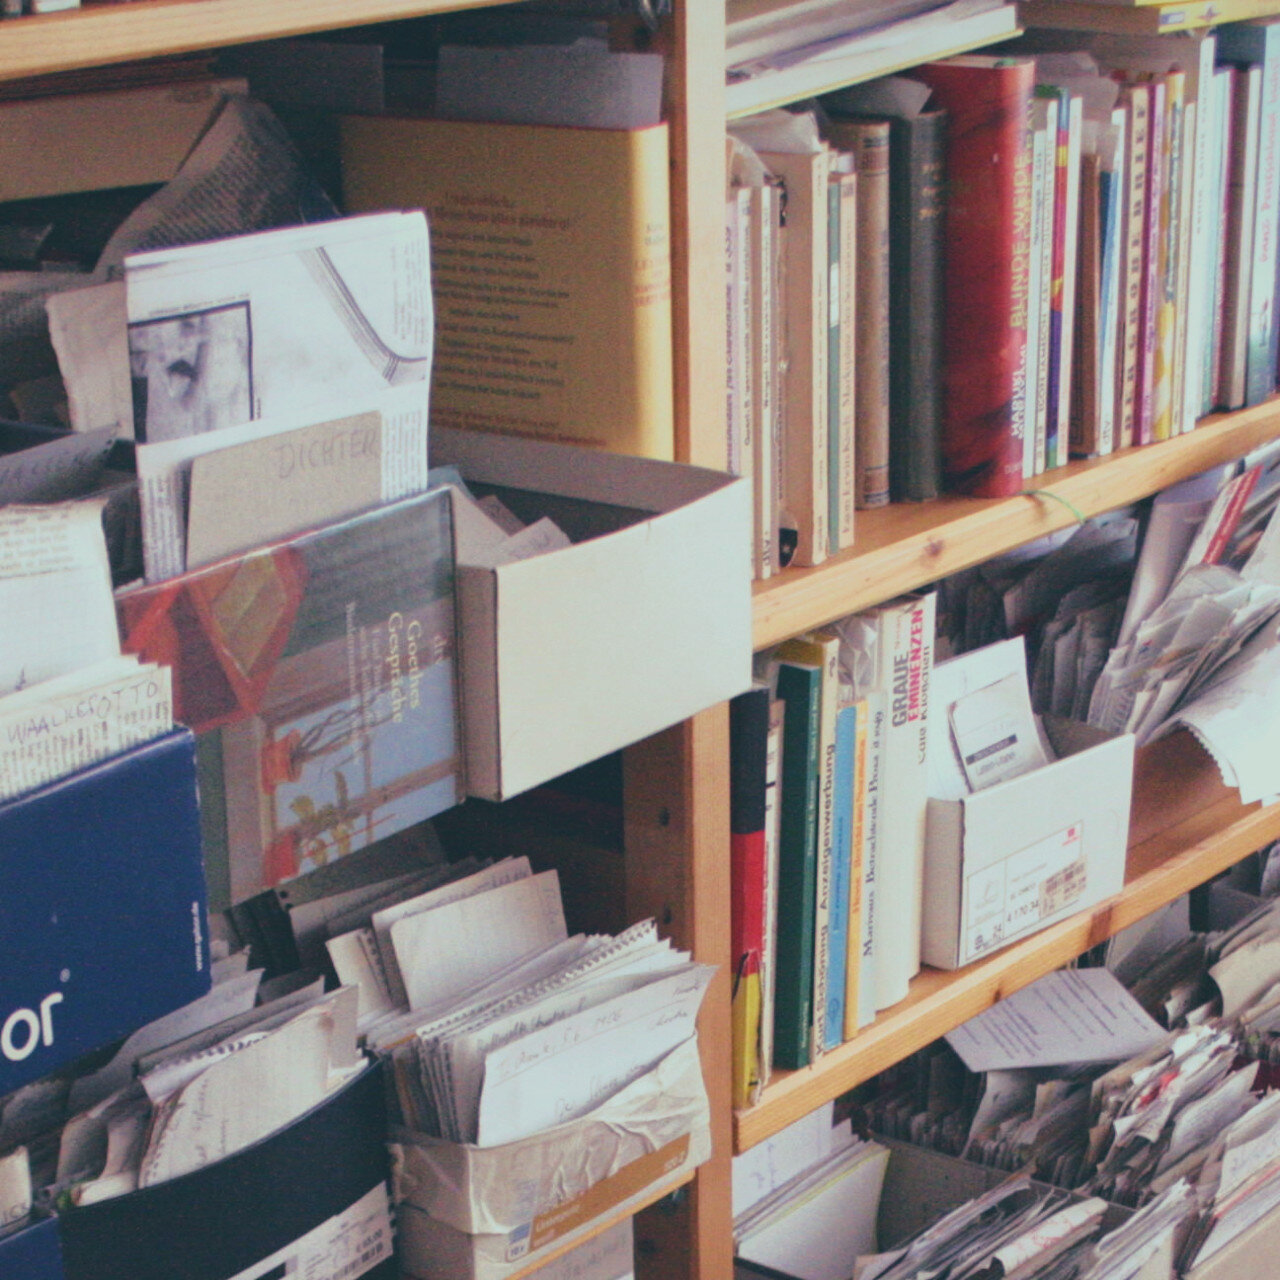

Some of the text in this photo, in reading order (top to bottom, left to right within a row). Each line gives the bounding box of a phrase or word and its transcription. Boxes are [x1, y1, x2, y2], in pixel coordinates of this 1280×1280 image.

[1008, 155, 1031, 329] BLINDE WEIDE
[385, 611, 408, 723] Gespräche
[406, 619, 424, 710] Goethes
[891, 650, 910, 729] GRAUE
[906, 607, 925, 723] EMINENZEN
